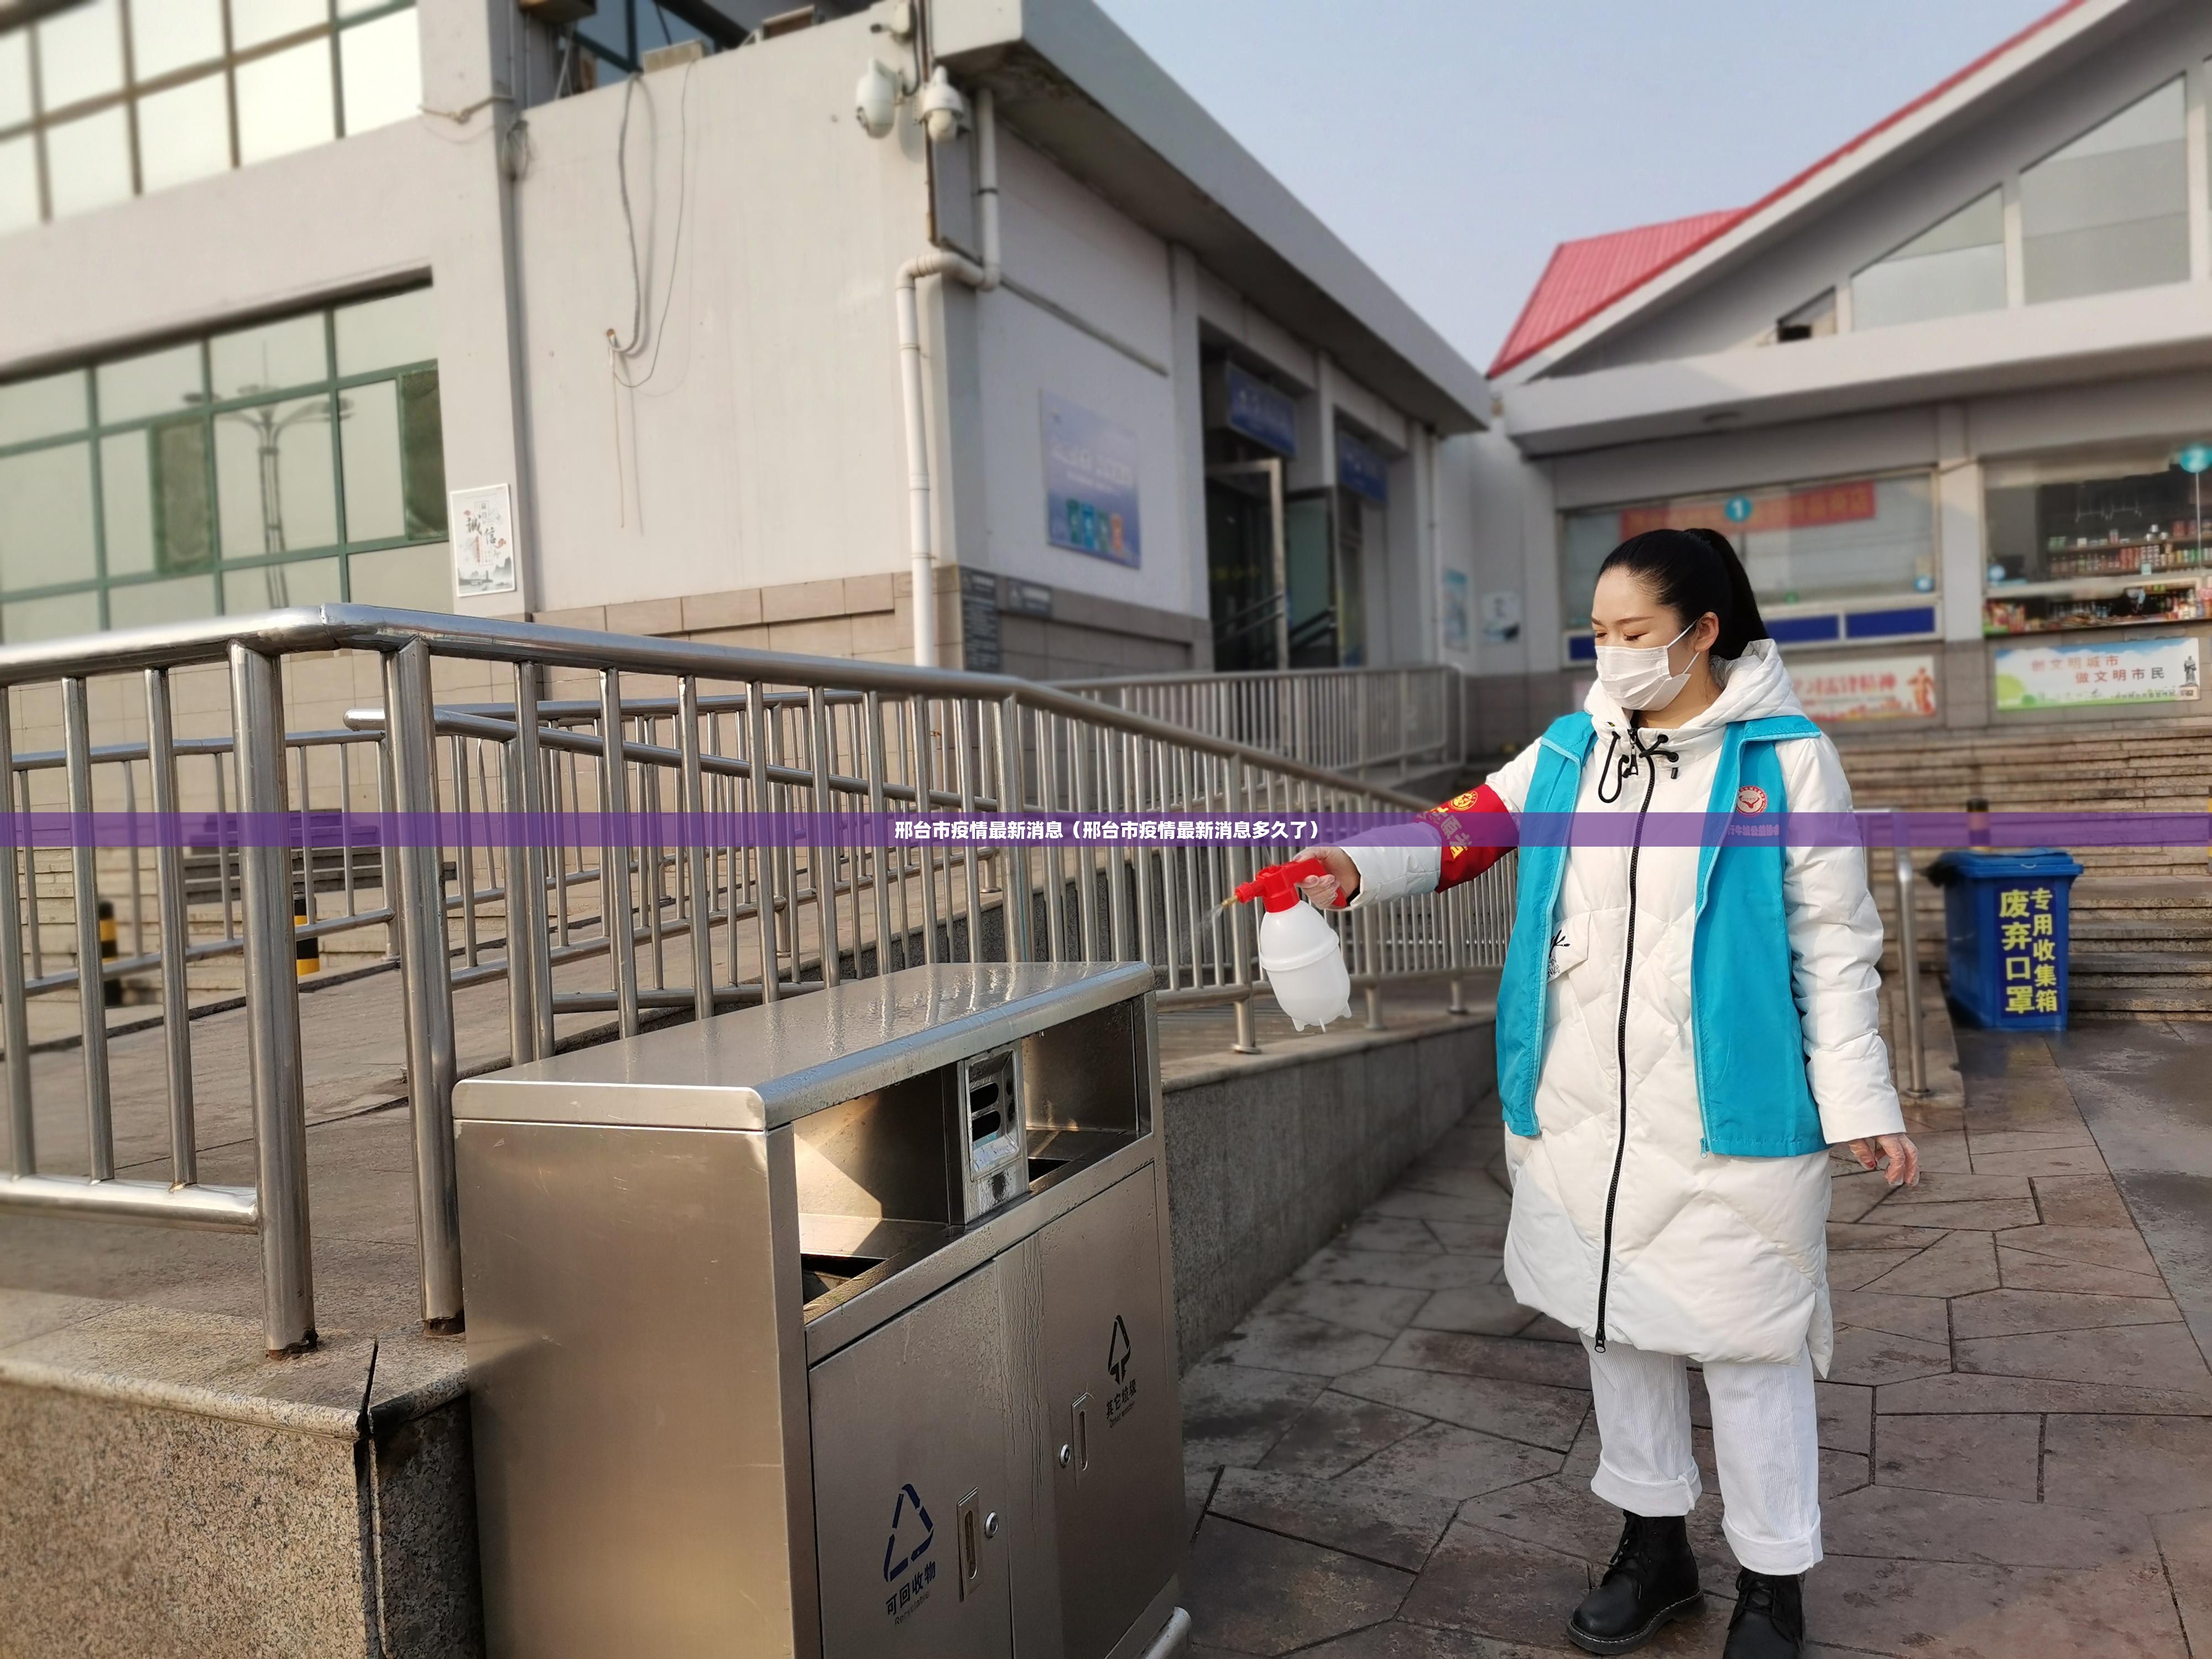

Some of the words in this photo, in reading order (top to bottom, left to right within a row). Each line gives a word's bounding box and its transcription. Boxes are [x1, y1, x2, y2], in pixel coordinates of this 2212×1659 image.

[2075, 667, 2165, 684] 做文明市民
[1999, 889, 2035, 1014] 废弃口罩
[2030, 888, 2058, 1013] 专用收集箱
[1107, 1379, 1136, 1420] 其它垃圾
[886, 1561, 936, 1615] 可回收物
